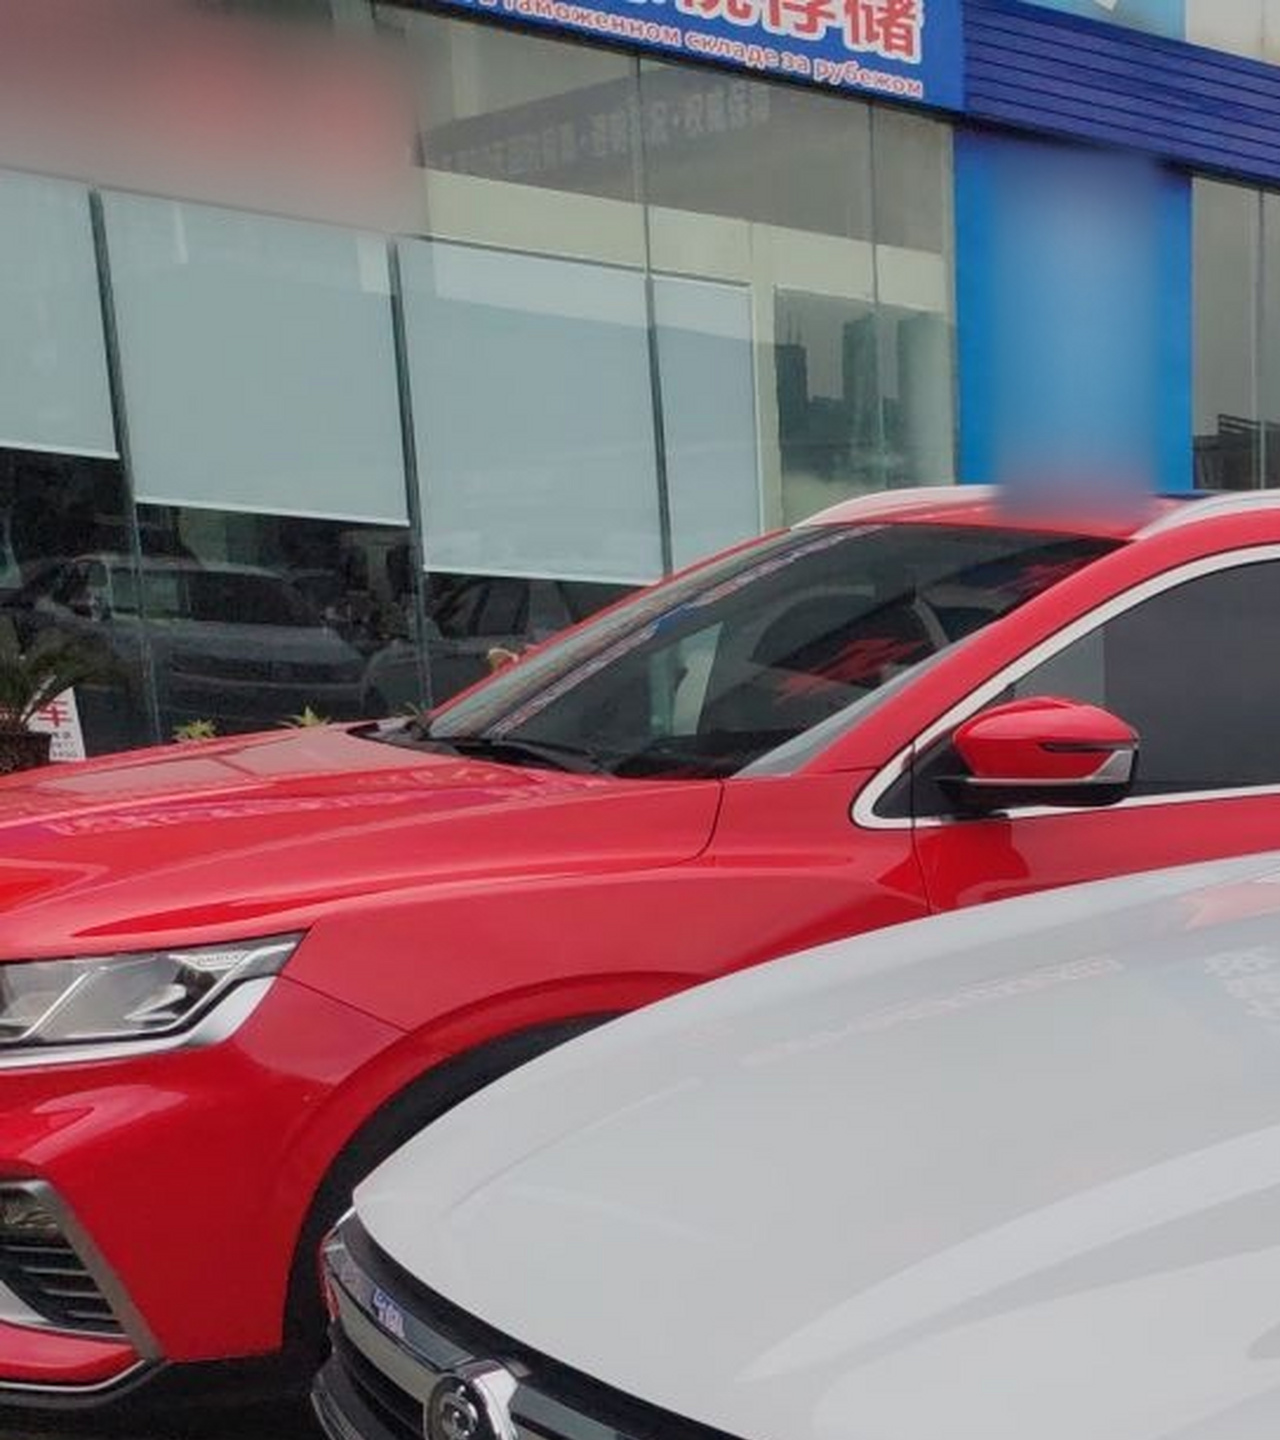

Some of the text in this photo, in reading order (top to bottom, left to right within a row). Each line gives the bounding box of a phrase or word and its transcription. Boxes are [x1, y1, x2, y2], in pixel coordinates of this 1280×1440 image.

[685, 31, 780, 69] складе
[780, 51, 812, 74] за
[813, 57, 923, 98] рубежом
